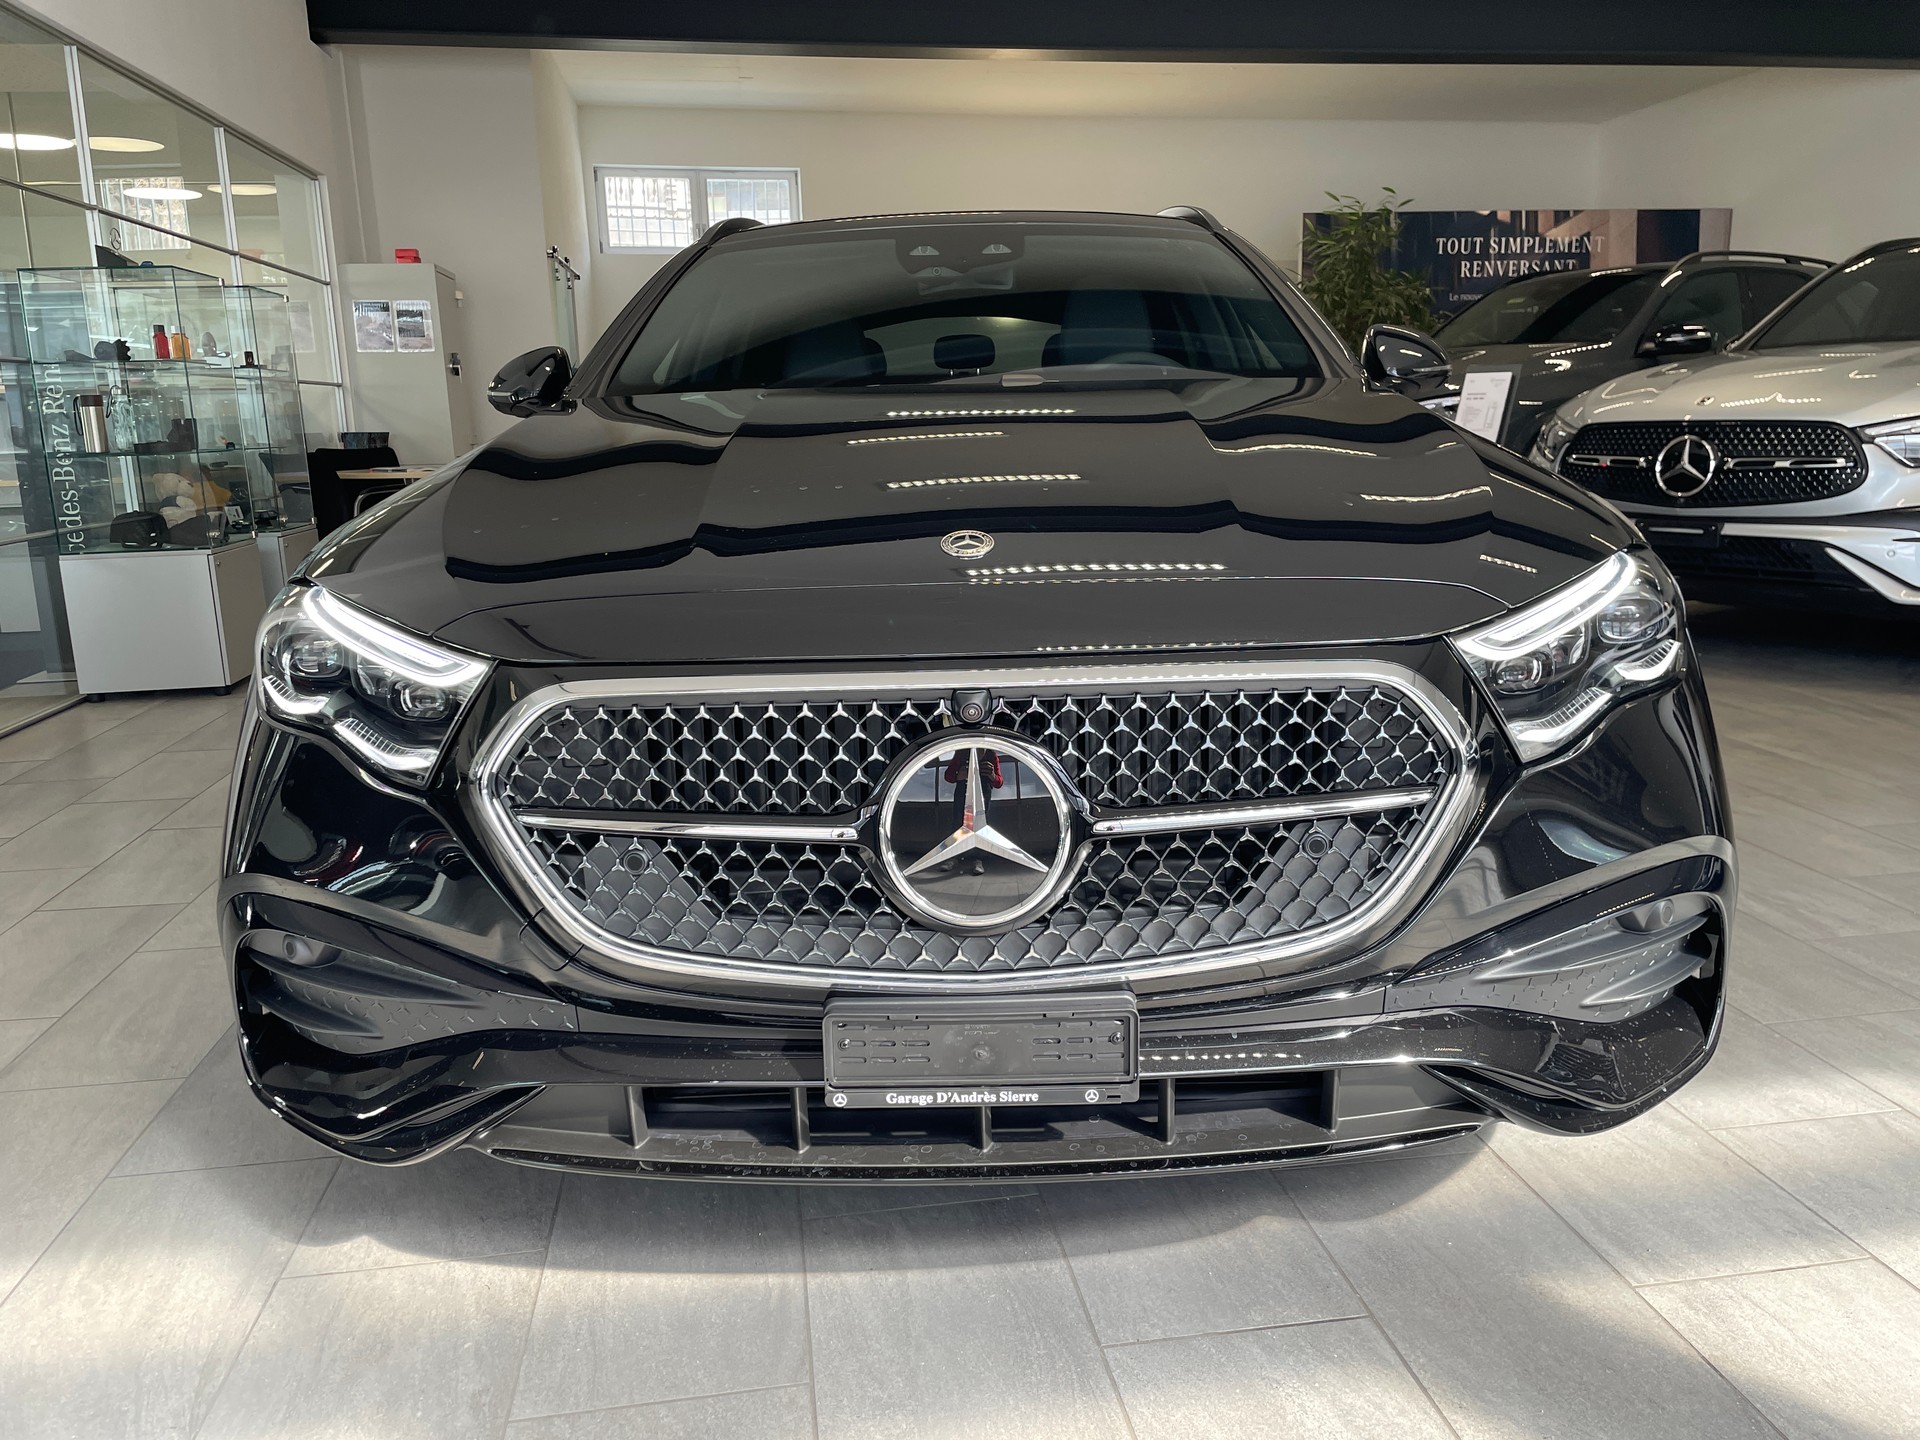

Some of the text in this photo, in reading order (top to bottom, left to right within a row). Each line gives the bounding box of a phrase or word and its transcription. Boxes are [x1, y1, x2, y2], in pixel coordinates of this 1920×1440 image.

[1436, 235, 1605, 255] TOUT SIMPLEMENT
[1460, 259, 1577, 278] RENVERSANT
[886, 1090, 1039, 1106] Garage D'Andrès Sierre
